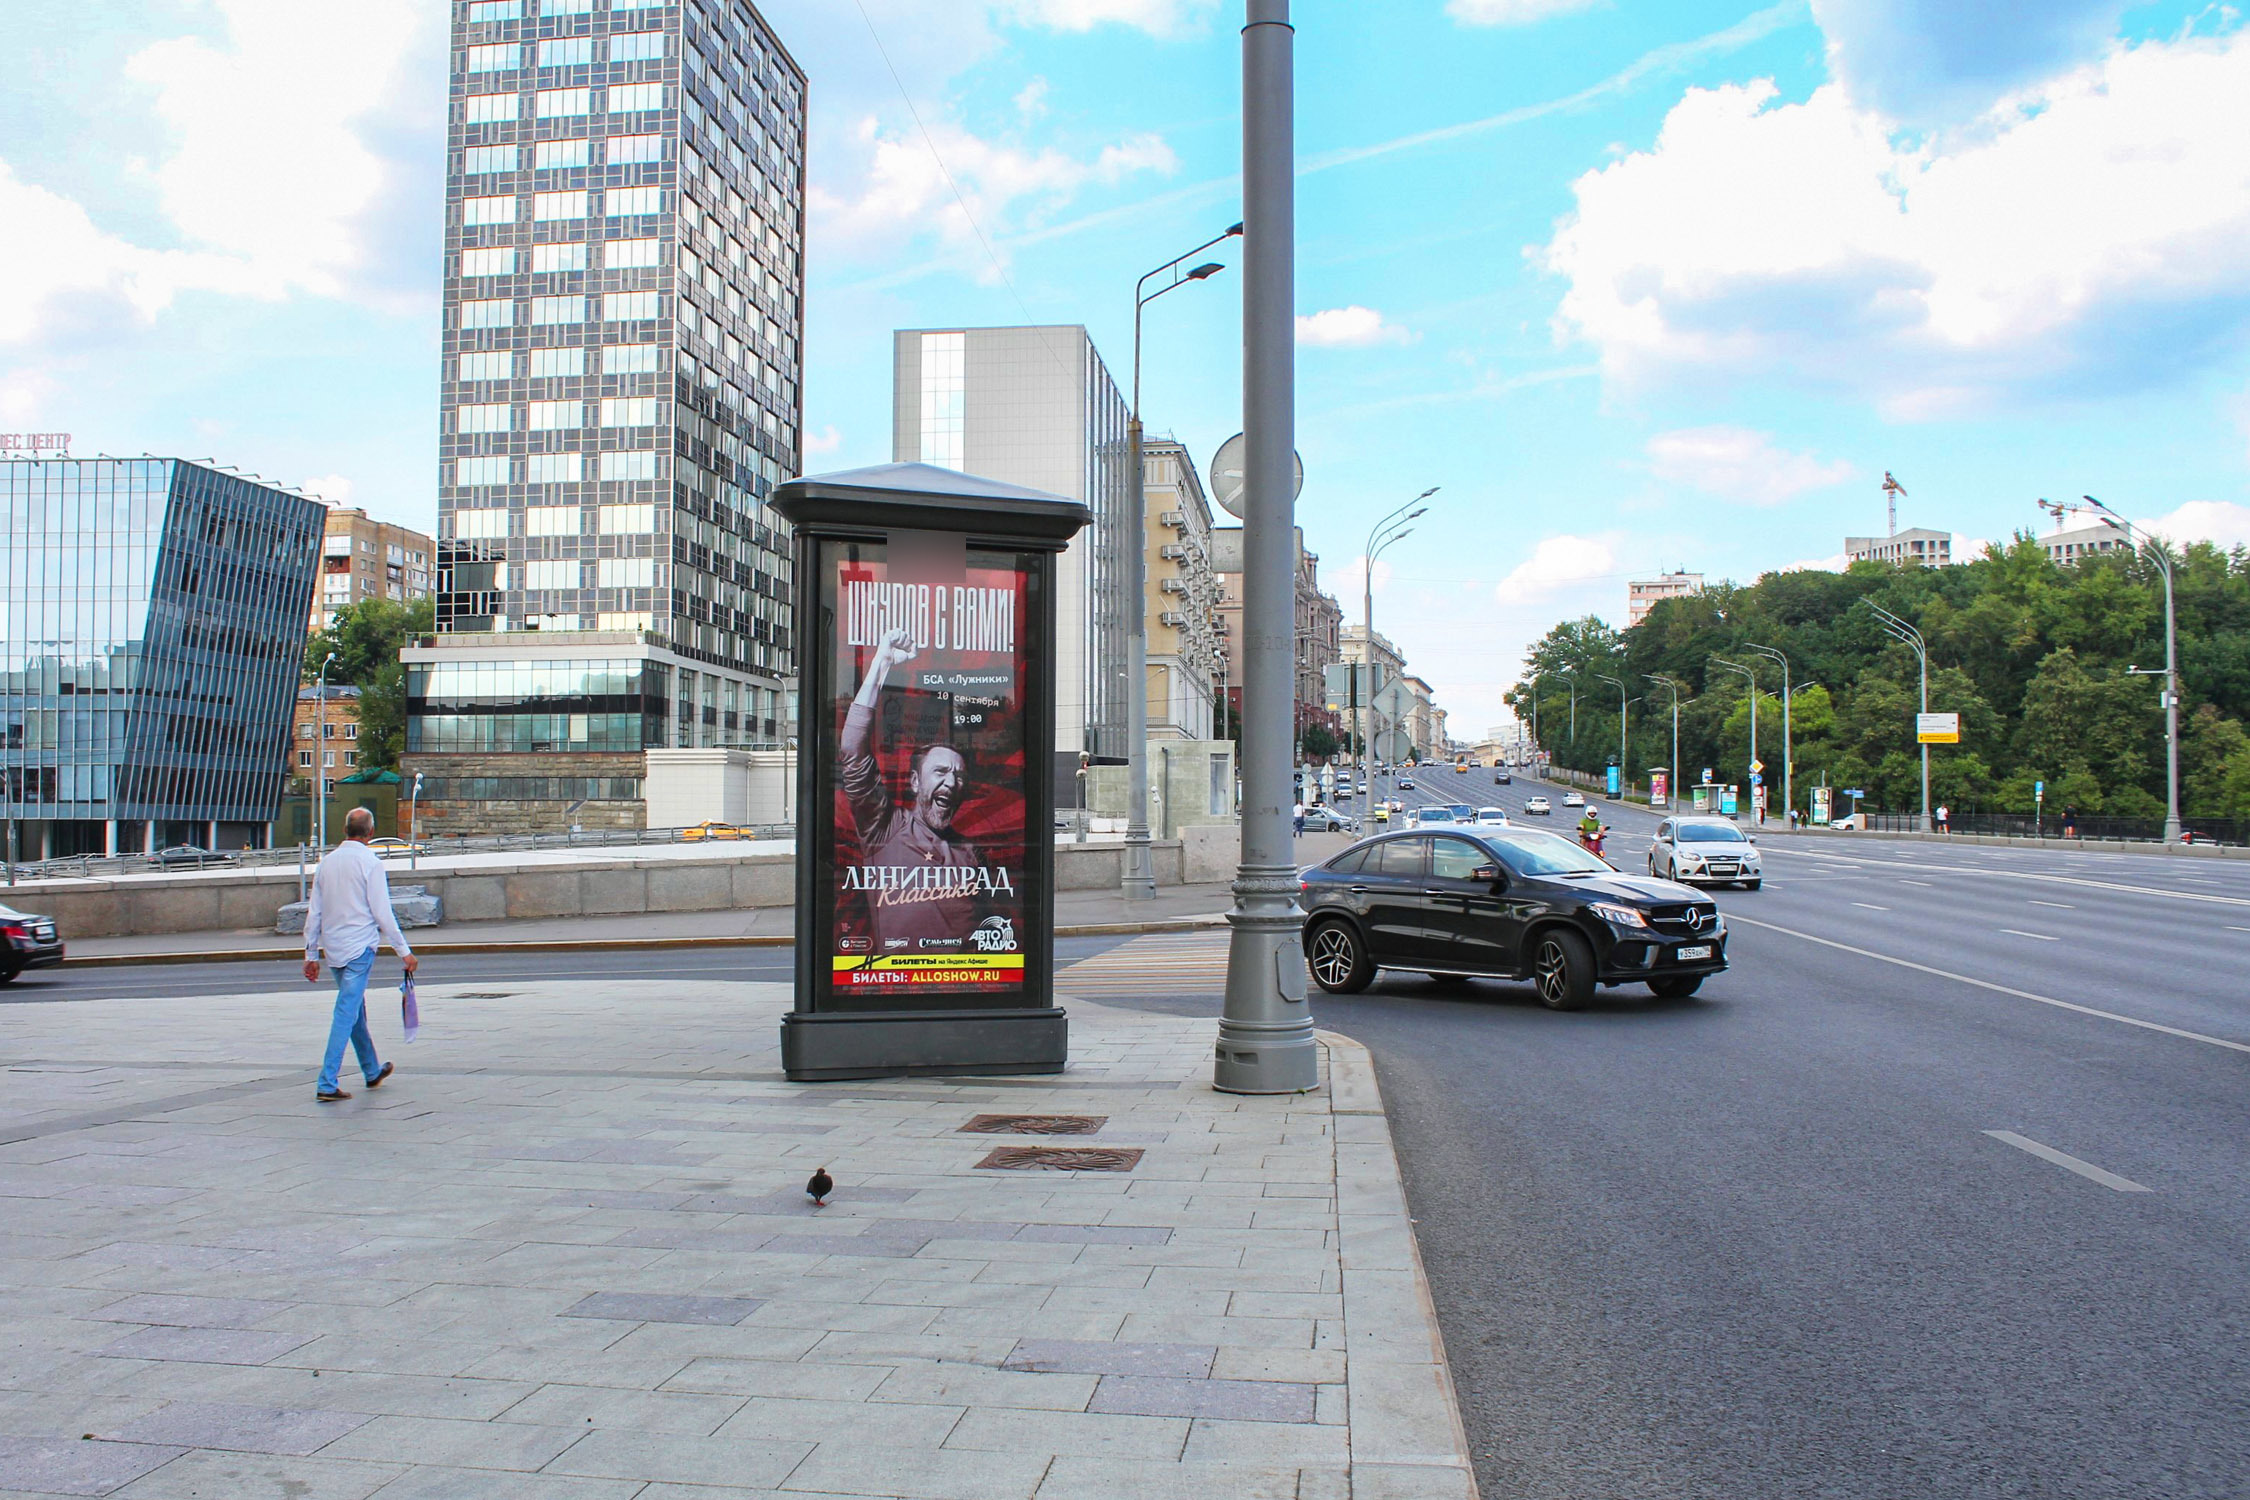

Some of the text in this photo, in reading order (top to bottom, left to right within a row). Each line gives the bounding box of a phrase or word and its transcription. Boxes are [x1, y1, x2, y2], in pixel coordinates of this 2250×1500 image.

[27, 432, 72, 449] ЦЕНТР
[848, 580, 1014, 652] ШНУРОВ С ВАМИ!
[923, 674, 1009, 687] БСА «Лужники»
[937, 691, 999, 707] 10 сентября
[953, 714, 982, 725] 19:00
[842, 866, 1014, 898] ЛЕНИНГРАД
[876, 880, 979, 908] Классика
[968, 929, 1001, 941] АВТО
[977, 940, 1018, 951] РАДИО
[852, 970, 1000, 983] БИЛЕТЫ: ALLOSHOW.RU
